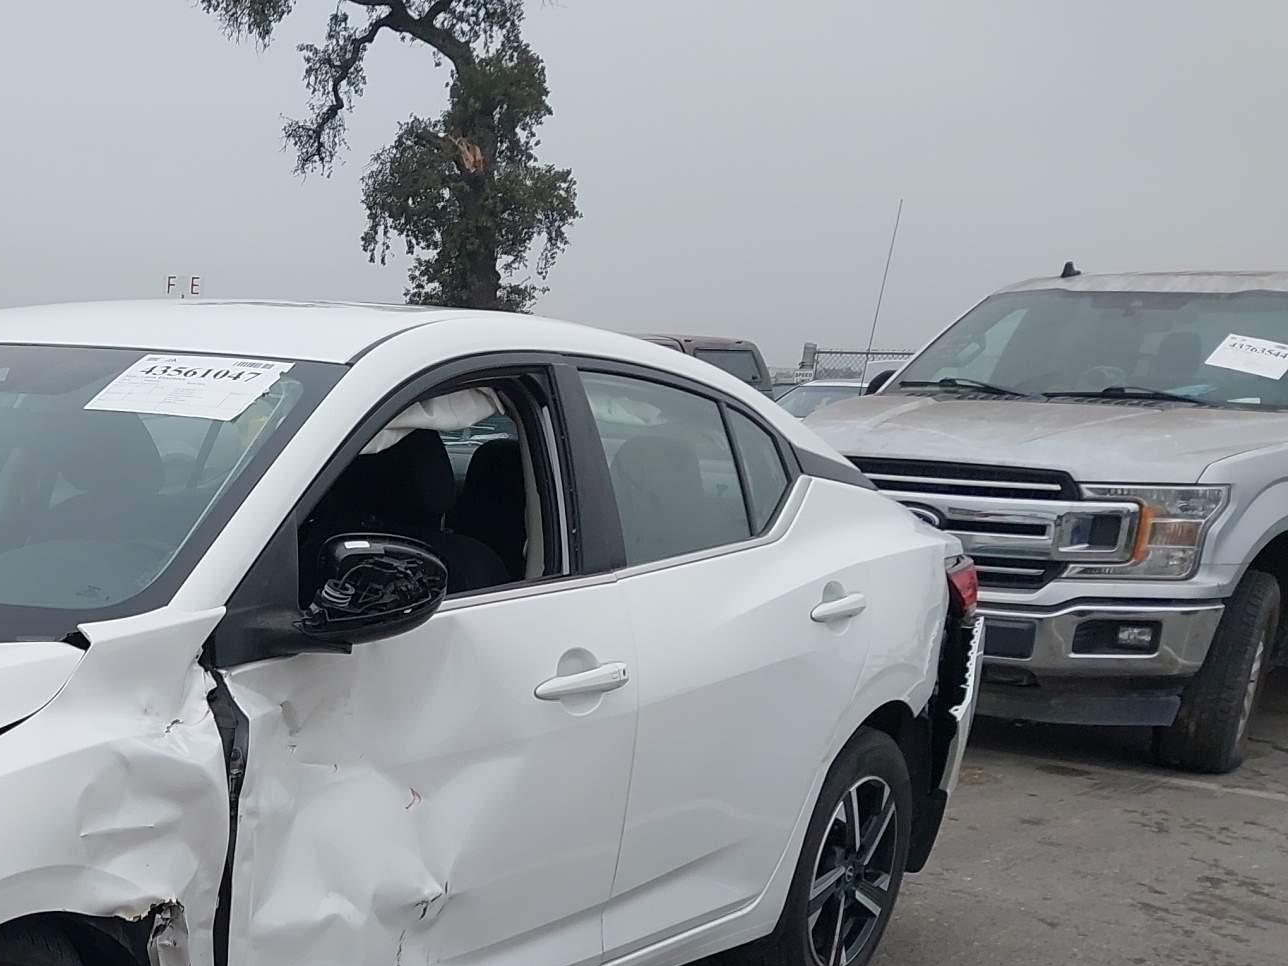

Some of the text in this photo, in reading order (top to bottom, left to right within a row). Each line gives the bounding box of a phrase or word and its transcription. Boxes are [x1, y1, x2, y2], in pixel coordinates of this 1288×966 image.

[167, 275, 201, 295] F E
[140, 364, 262, 383] 43561047
